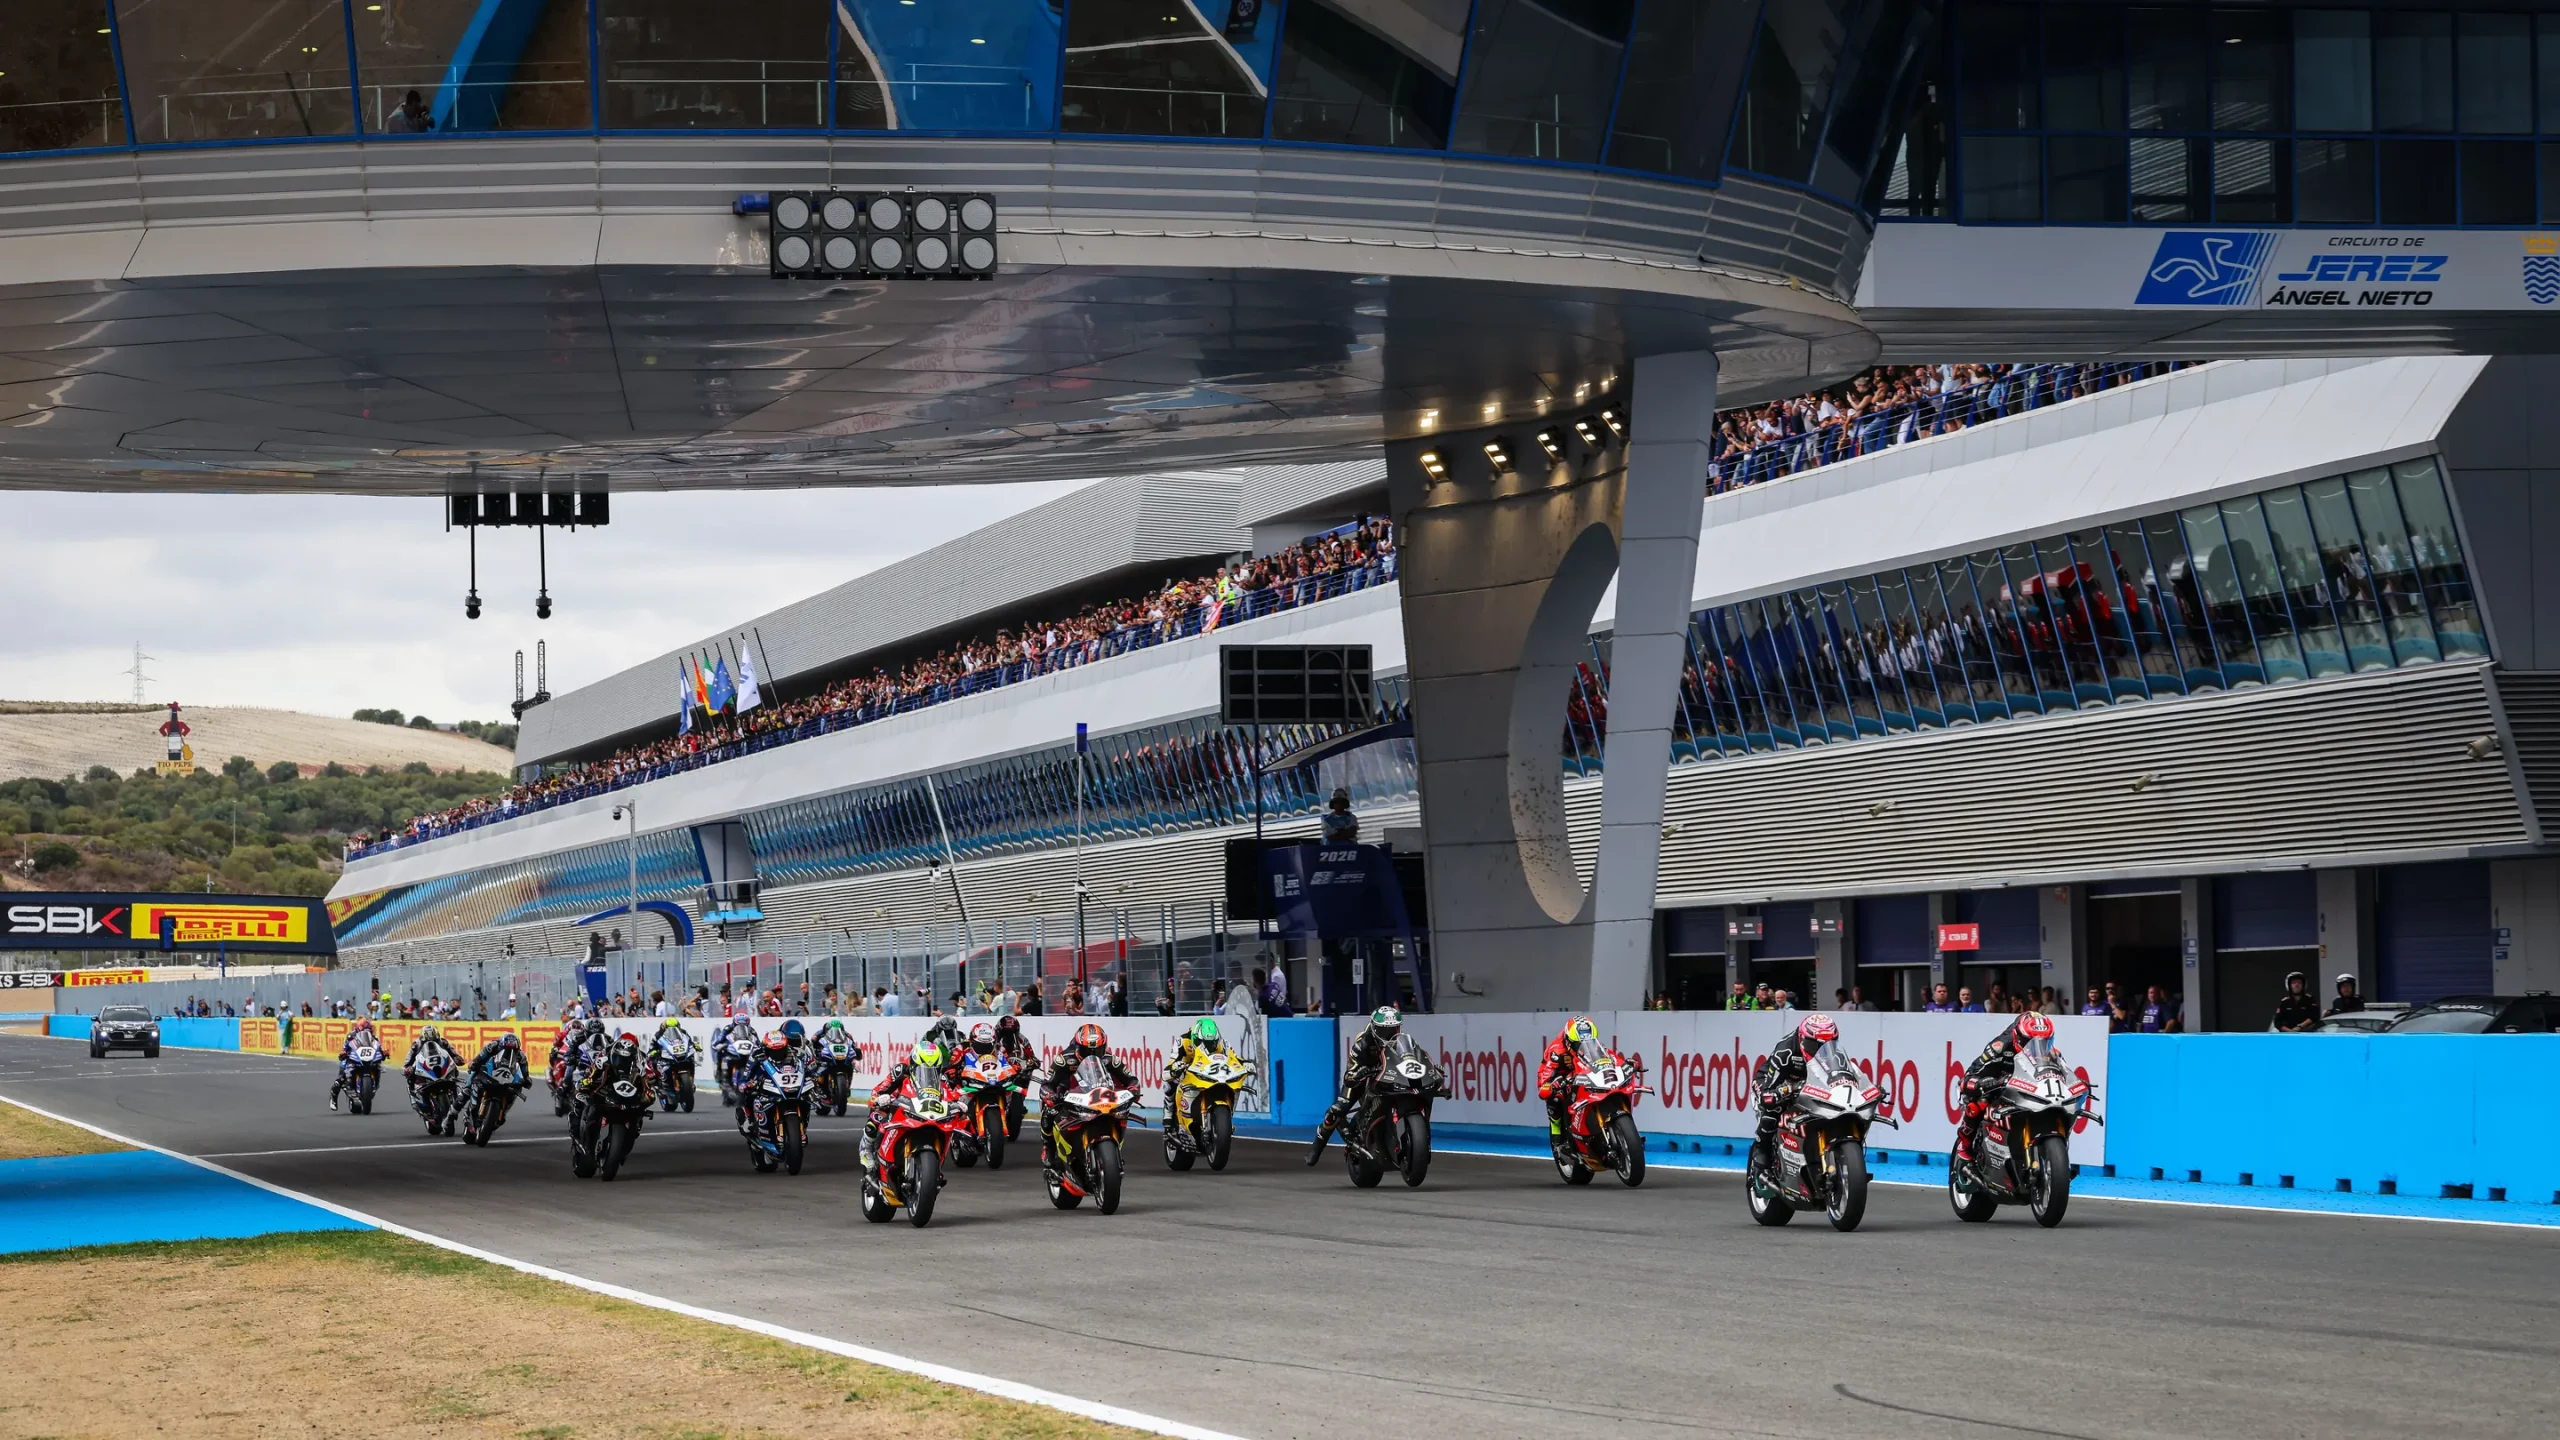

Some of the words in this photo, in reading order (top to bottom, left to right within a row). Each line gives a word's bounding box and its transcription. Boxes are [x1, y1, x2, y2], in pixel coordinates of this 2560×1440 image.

[2328, 236, 2398, 247] CIRCUITO
[2403, 236, 2425, 247] DE
[2278, 255, 2449, 282] JEREZ
[2266, 285, 2351, 306] ÁNGEL
[2357, 290, 2433, 306] NIETO
[1319, 850, 1357, 862] 2026
[8, 906, 124, 934] SBK
[150, 908, 289, 938] PRELLI
[177, 929, 220, 940] PIRELLI
[19, 973, 62, 987] SBK
[71, 970, 144, 986] PIRELLI
[360, 1046, 372, 1057] 85
[673, 1045, 686, 1053] 55
[833, 1045, 847, 1053] 62
[428, 1056, 442, 1067] 9
[982, 1062, 998, 1073] 67
[496, 1069, 511, 1080] 76
[1207, 1063, 1231, 1075] 34
[1405, 1062, 1423, 1075] 22
[781, 1074, 799, 1085] 97
[1602, 1069, 1619, 1085] 5
[2012, 1079, 2035, 1091] Lenovo
[2043, 1078, 2065, 1099] 11
[1088, 1088, 1118, 1106] 14
[1805, 1087, 1829, 1098] Lenovo
[1842, 1085, 1853, 1104] 7
[919, 1099, 944, 1114] 19
